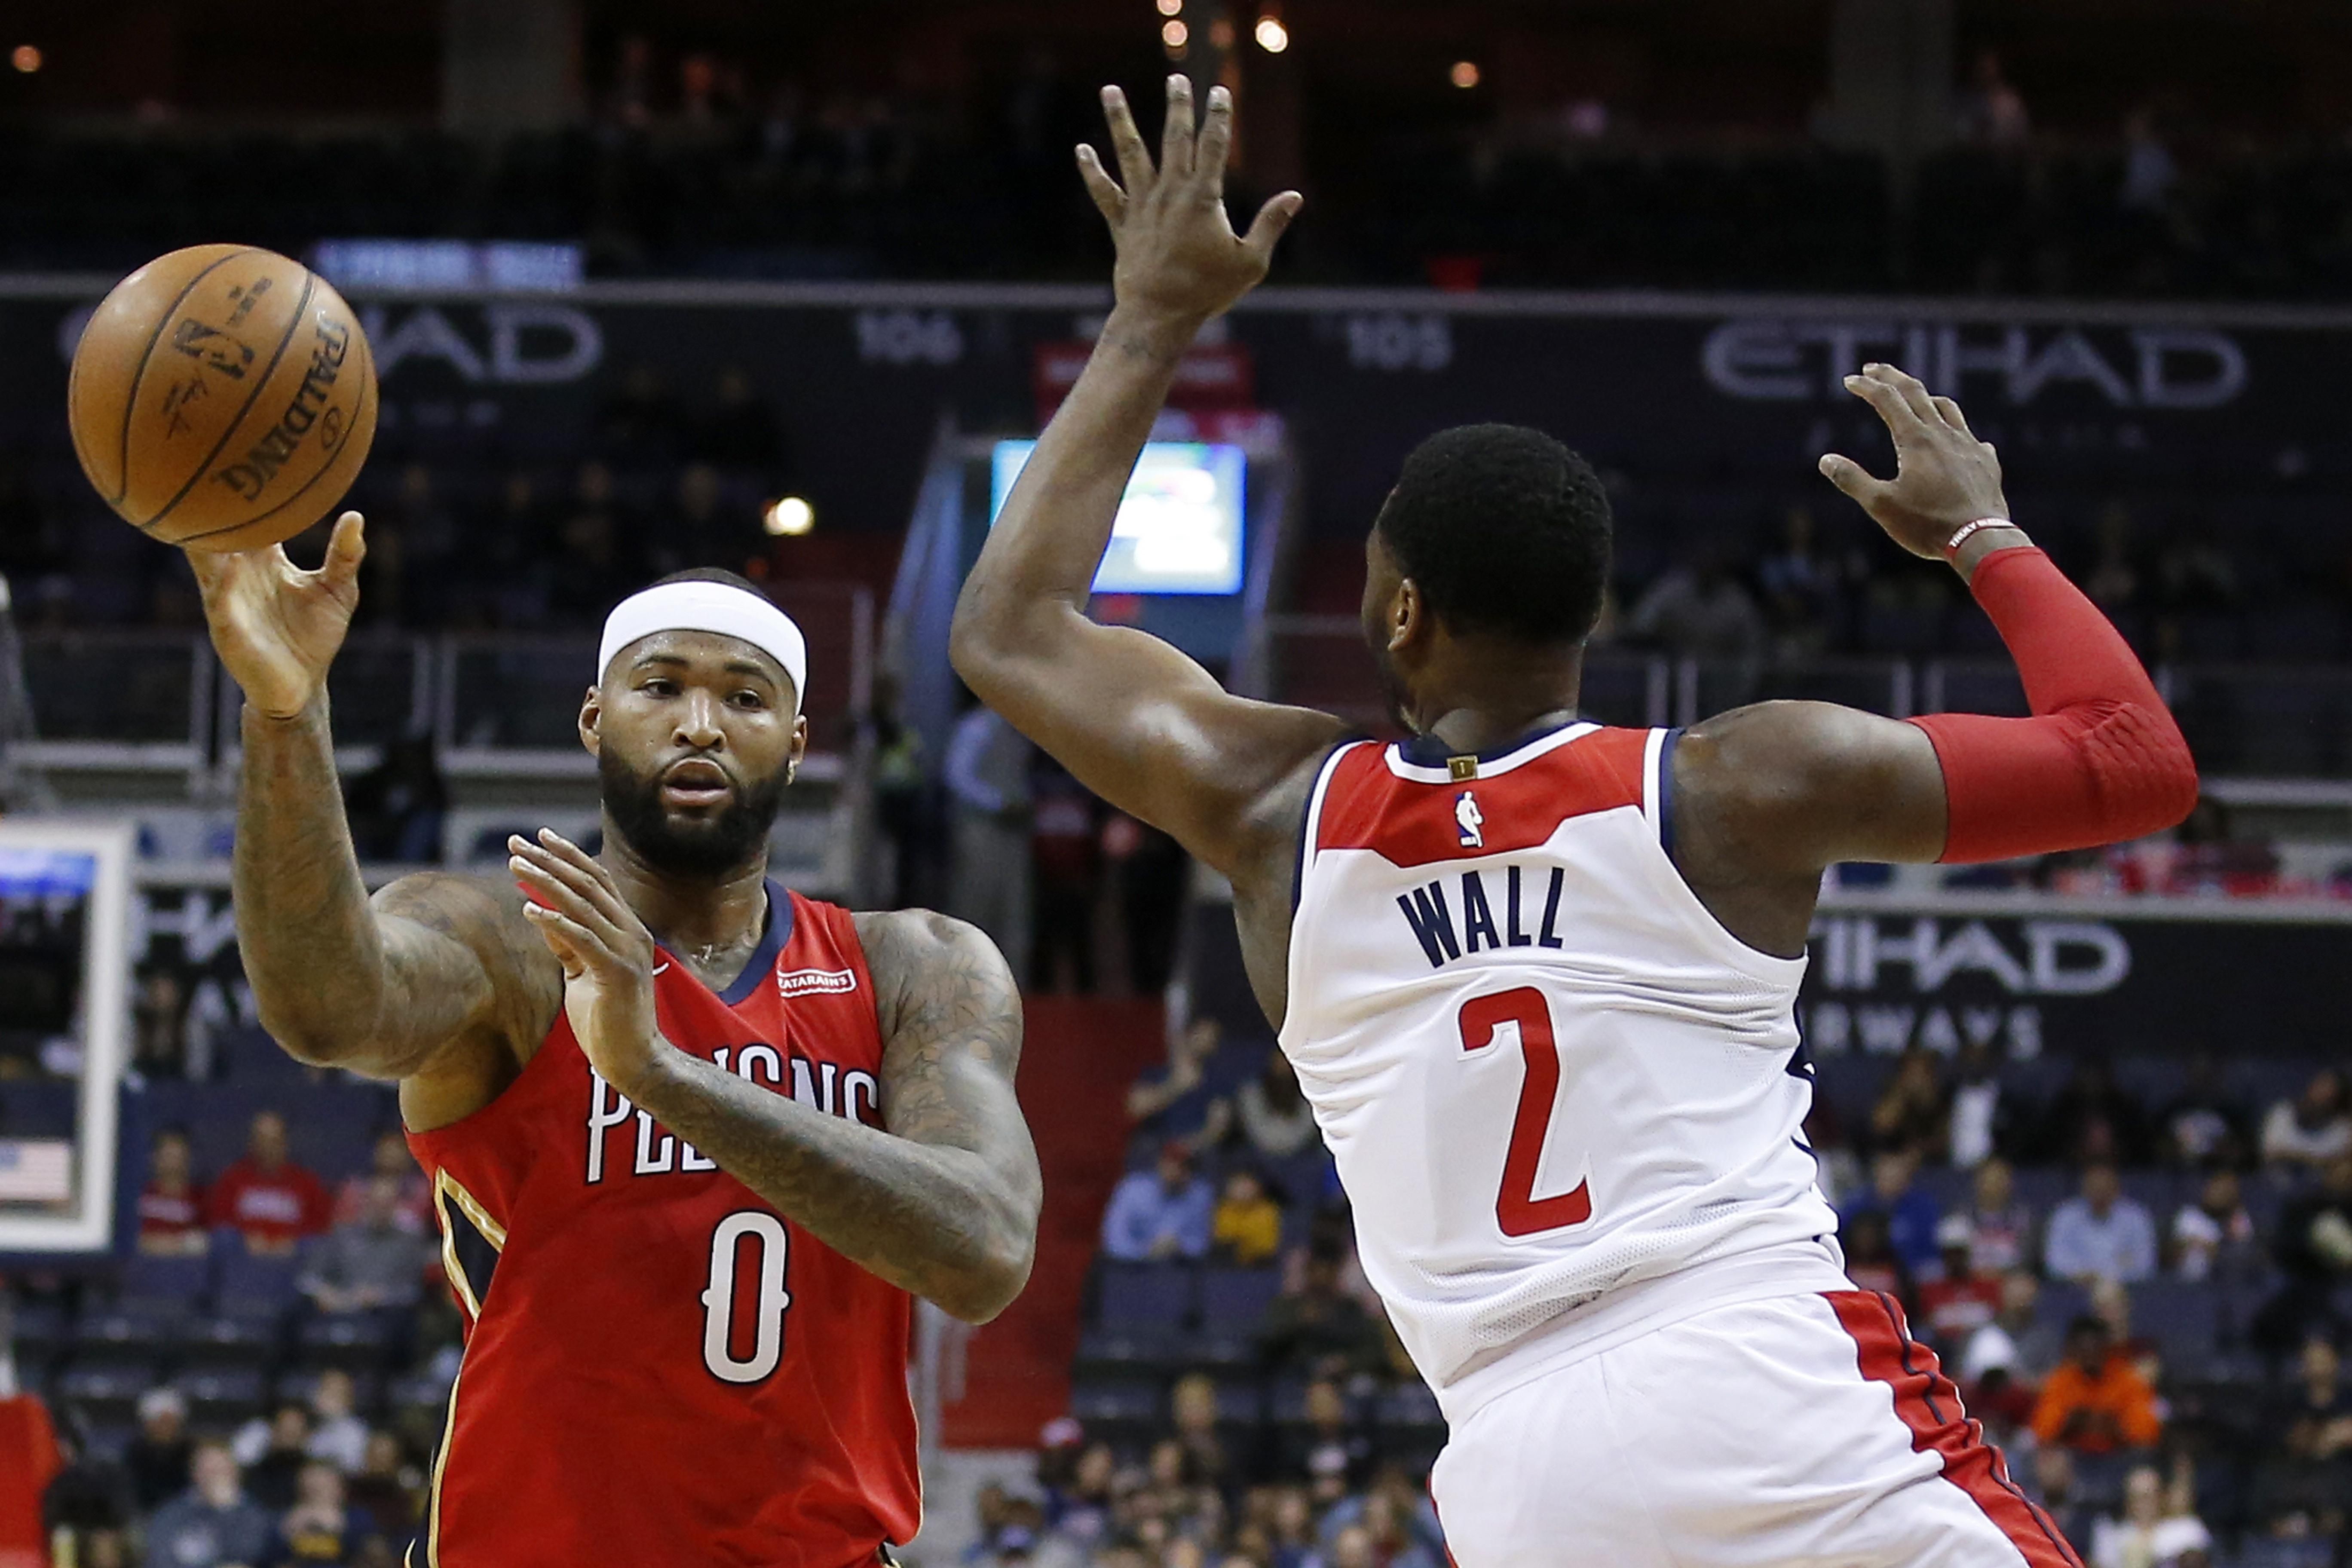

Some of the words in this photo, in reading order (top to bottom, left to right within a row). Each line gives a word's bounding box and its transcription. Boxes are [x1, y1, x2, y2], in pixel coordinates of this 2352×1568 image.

[217, 310, 349, 501] SPALDING
[1701, 318, 2247, 410] ETIHAD
[1396, 866, 1564, 968] WALL
[1807, 916, 2133, 996] IHAD
[1457, 985, 1593, 1238] 2
[701, 1211, 790, 1383] 0
